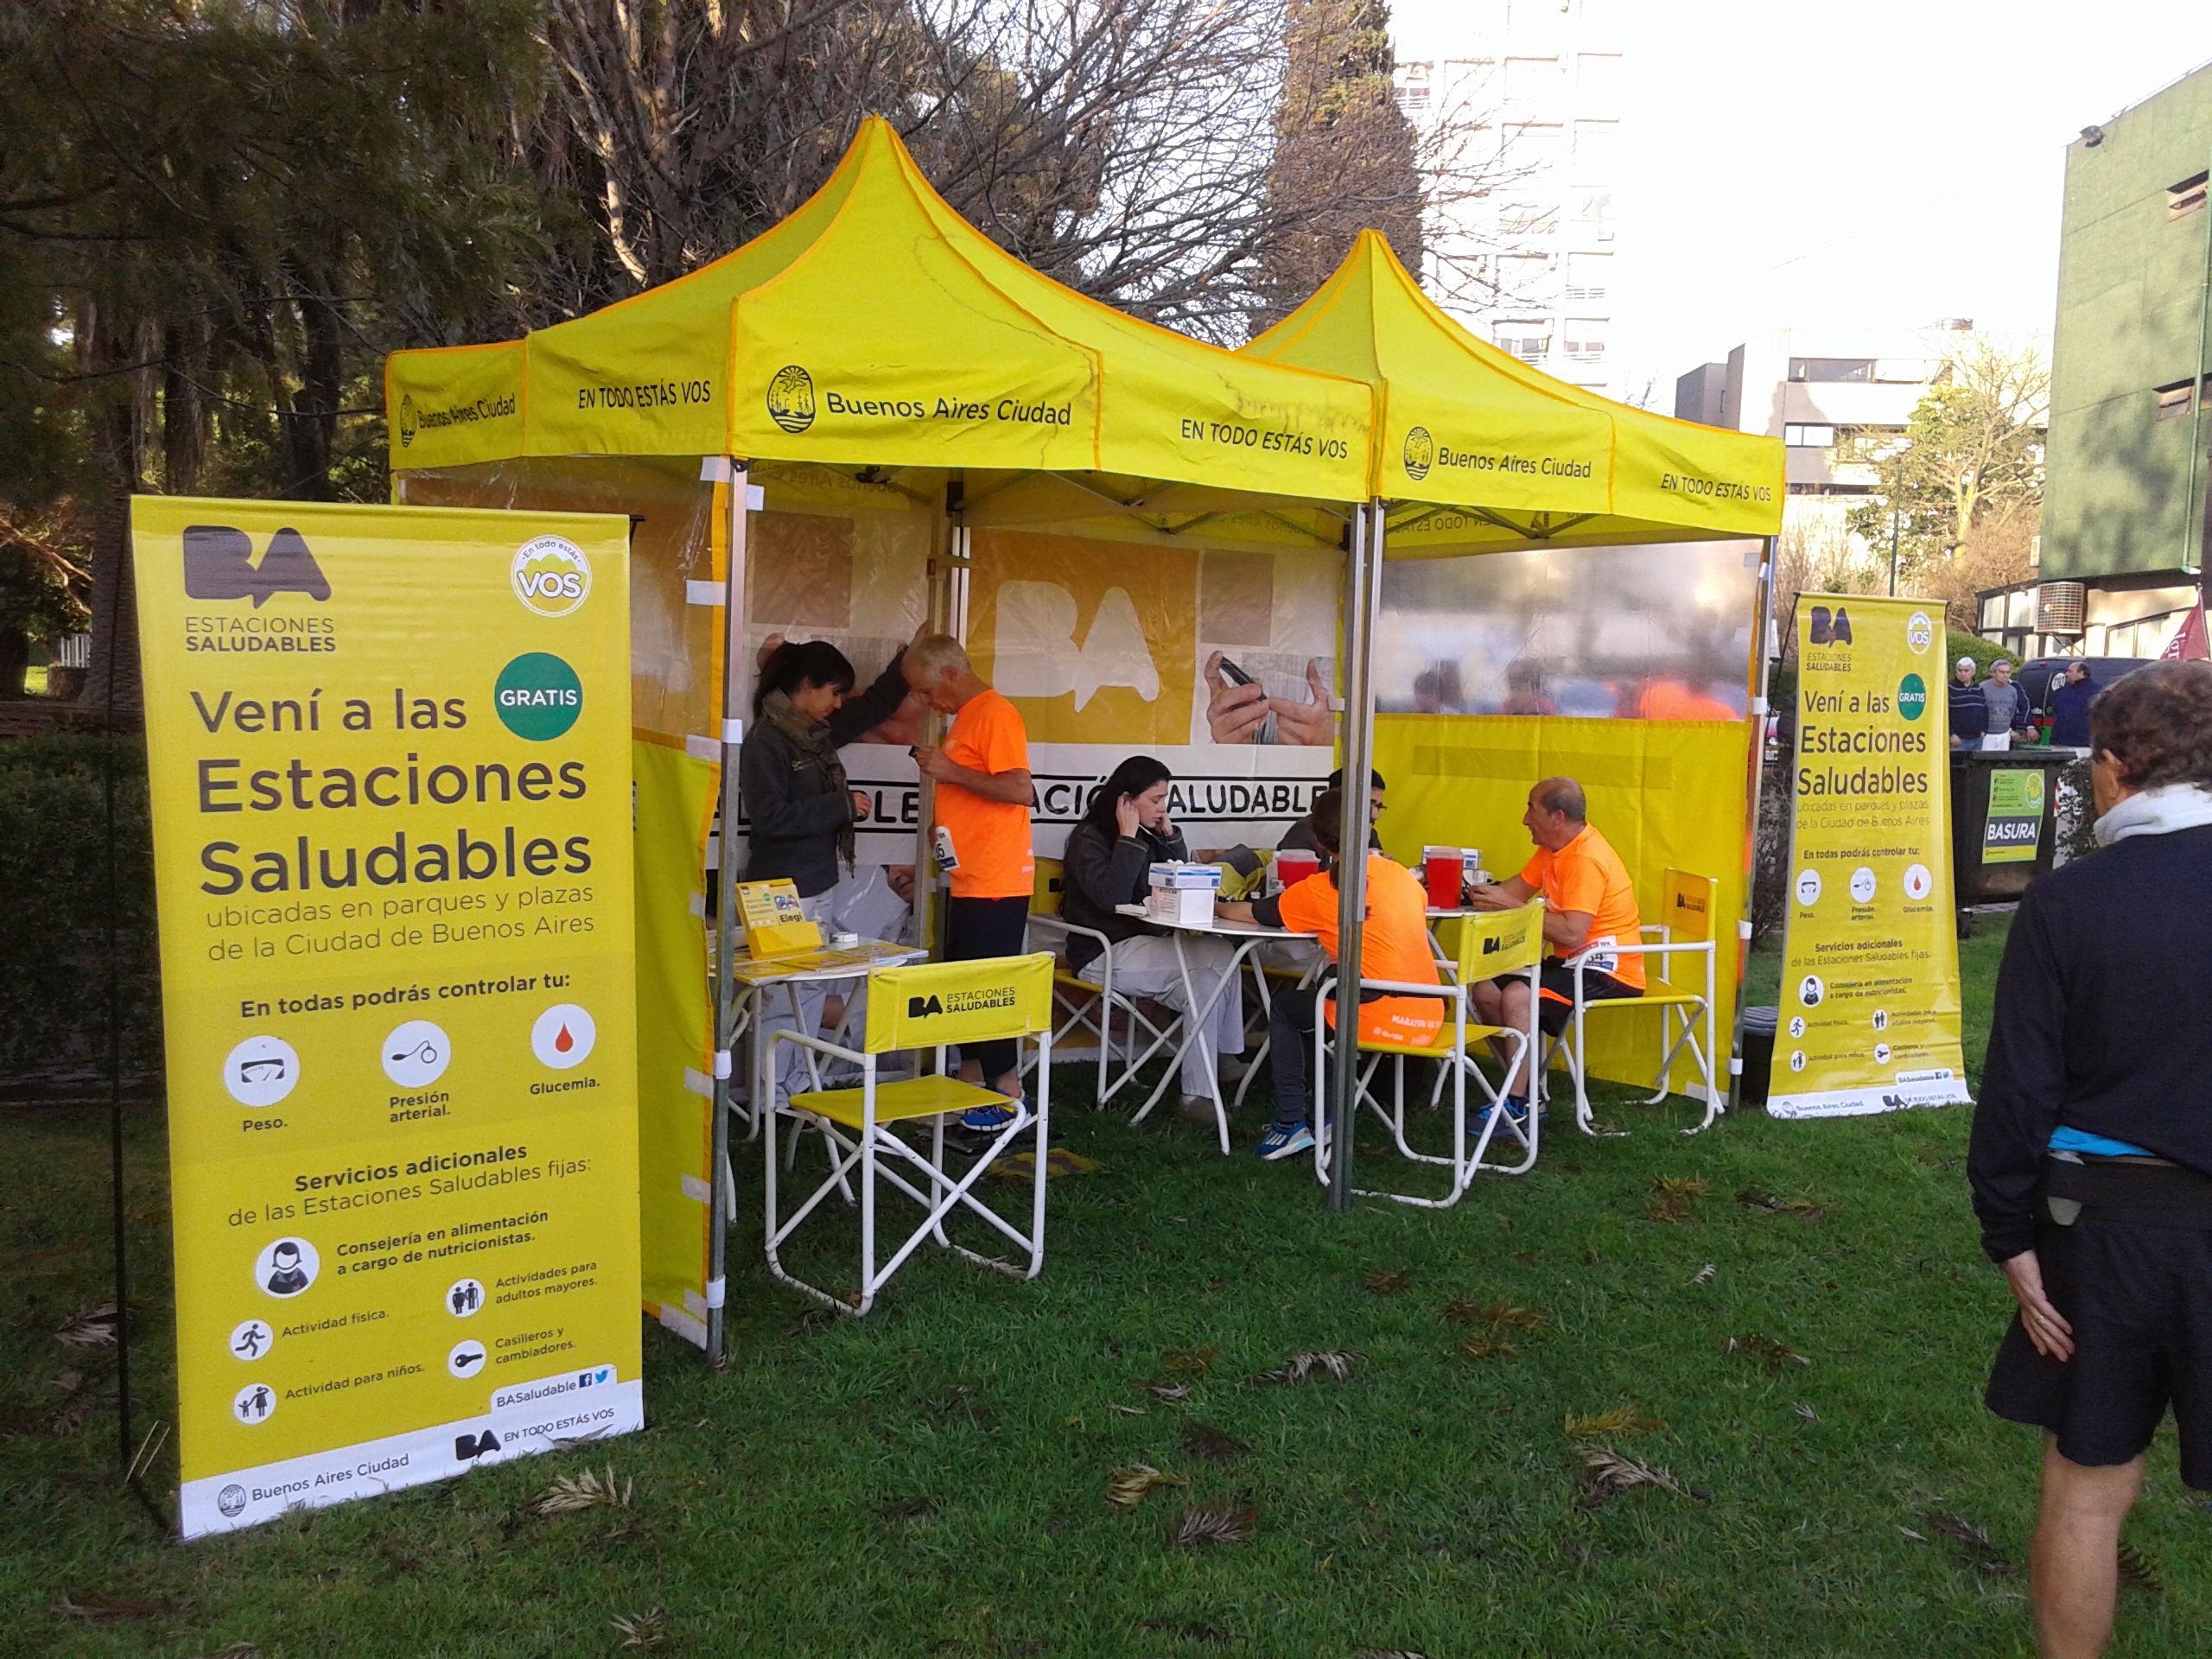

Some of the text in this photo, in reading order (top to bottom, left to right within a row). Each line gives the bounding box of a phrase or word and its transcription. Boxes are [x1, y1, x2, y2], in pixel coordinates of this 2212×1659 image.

[477, 392, 515, 419] Ciudad
[578, 379, 711, 410] EN TODO ESTÁS VOS
[826, 391, 1071, 425] Buenos Aires Ciudad
[1182, 419, 1347, 459] EN TODO ESTÁS VOS
[1439, 448, 1591, 478] Buenos Aires Ciudad
[1661, 474, 1770, 501] EN TODO ESTÁS VOS
[524, 541, 578, 559] En todo estás
[182, 524, 332, 609] BA
[517, 571, 582, 598] VOS
[186, 617, 334, 633] ESTACIONES
[1809, 607, 1853, 648] BA
[1910, 631, 1929, 645] VOS
[186, 636, 336, 652] SALUDABLES
[994, 580, 1160, 713] BA
[1807, 652, 1851, 662] ESTACIONES
[1806, 663, 1851, 671] SALUDABLES
[190, 688, 467, 733] Vení a las
[499, 688, 577, 707] GRATIS
[1805, 690, 1889, 713] Vení a las
[1899, 693, 1925, 702] GRATIS
[1801, 725, 1926, 753] Estaciones
[199, 753, 587, 812] Estaciones
[1797, 766, 1928, 795] Saludables
[1167, 784, 1330, 814] ALUDABLE
[1900, 798, 1929, 812] plazas
[1905, 816, 1929, 826] Aires
[1987, 822, 2035, 840] BASURA
[200, 826, 592, 896] Saludables
[1804, 850, 1814, 859] En
[1816, 849, 1838, 858] todas
[1840, 848, 1870, 859] podrás
[1872, 847, 1906, 856] controlar
[207, 886, 594, 928] ubicadas en parques y plazas
[208, 915, 594, 961] de la Ciudad de Buenos Aires
[1815, 939, 1903, 952] Servicios adicionales
[1804, 957, 1815, 965] las
[1818, 953, 1863, 964] Estaciones
[1866, 951, 1908, 962] Saludables
[241, 972, 570, 1018] En todas podrás controlar tu:
[908, 995, 943, 1018] BA
[947, 987, 1015, 1002] ESTACIONES
[947, 997, 1015, 1013] SALUDABLES
[390, 1090, 449, 1108] Presión
[531, 1077, 601, 1096] Glucemia.
[243, 1117, 288, 1132] Peso.
[390, 1105, 450, 1122] arterial.
[295, 1144, 527, 1192] Servicios adicionales
[228, 1156, 591, 1226] de las Estaciones Saludables fijas:
[337, 1211, 548, 1257] Consejería en alimentación
[337, 1230, 536, 1274] a cargo de nutricionistas.
[496, 1260, 597, 1288] Actividades para
[496, 1276, 597, 1304] adultos mayores.
[283, 1317, 347, 1338] Actividad
[495, 1328, 564, 1349] Casilleros y
[495, 1339, 576, 1364] cambiadores.
[285, 1364, 425, 1400] Actividad para niños.
[497, 1380, 576, 1408] BASaludable
[455, 1408, 614, 1463] BA EN TODO ESTÁS VOS
[252, 1454, 410, 1501] Buenos Aires Ciudad
